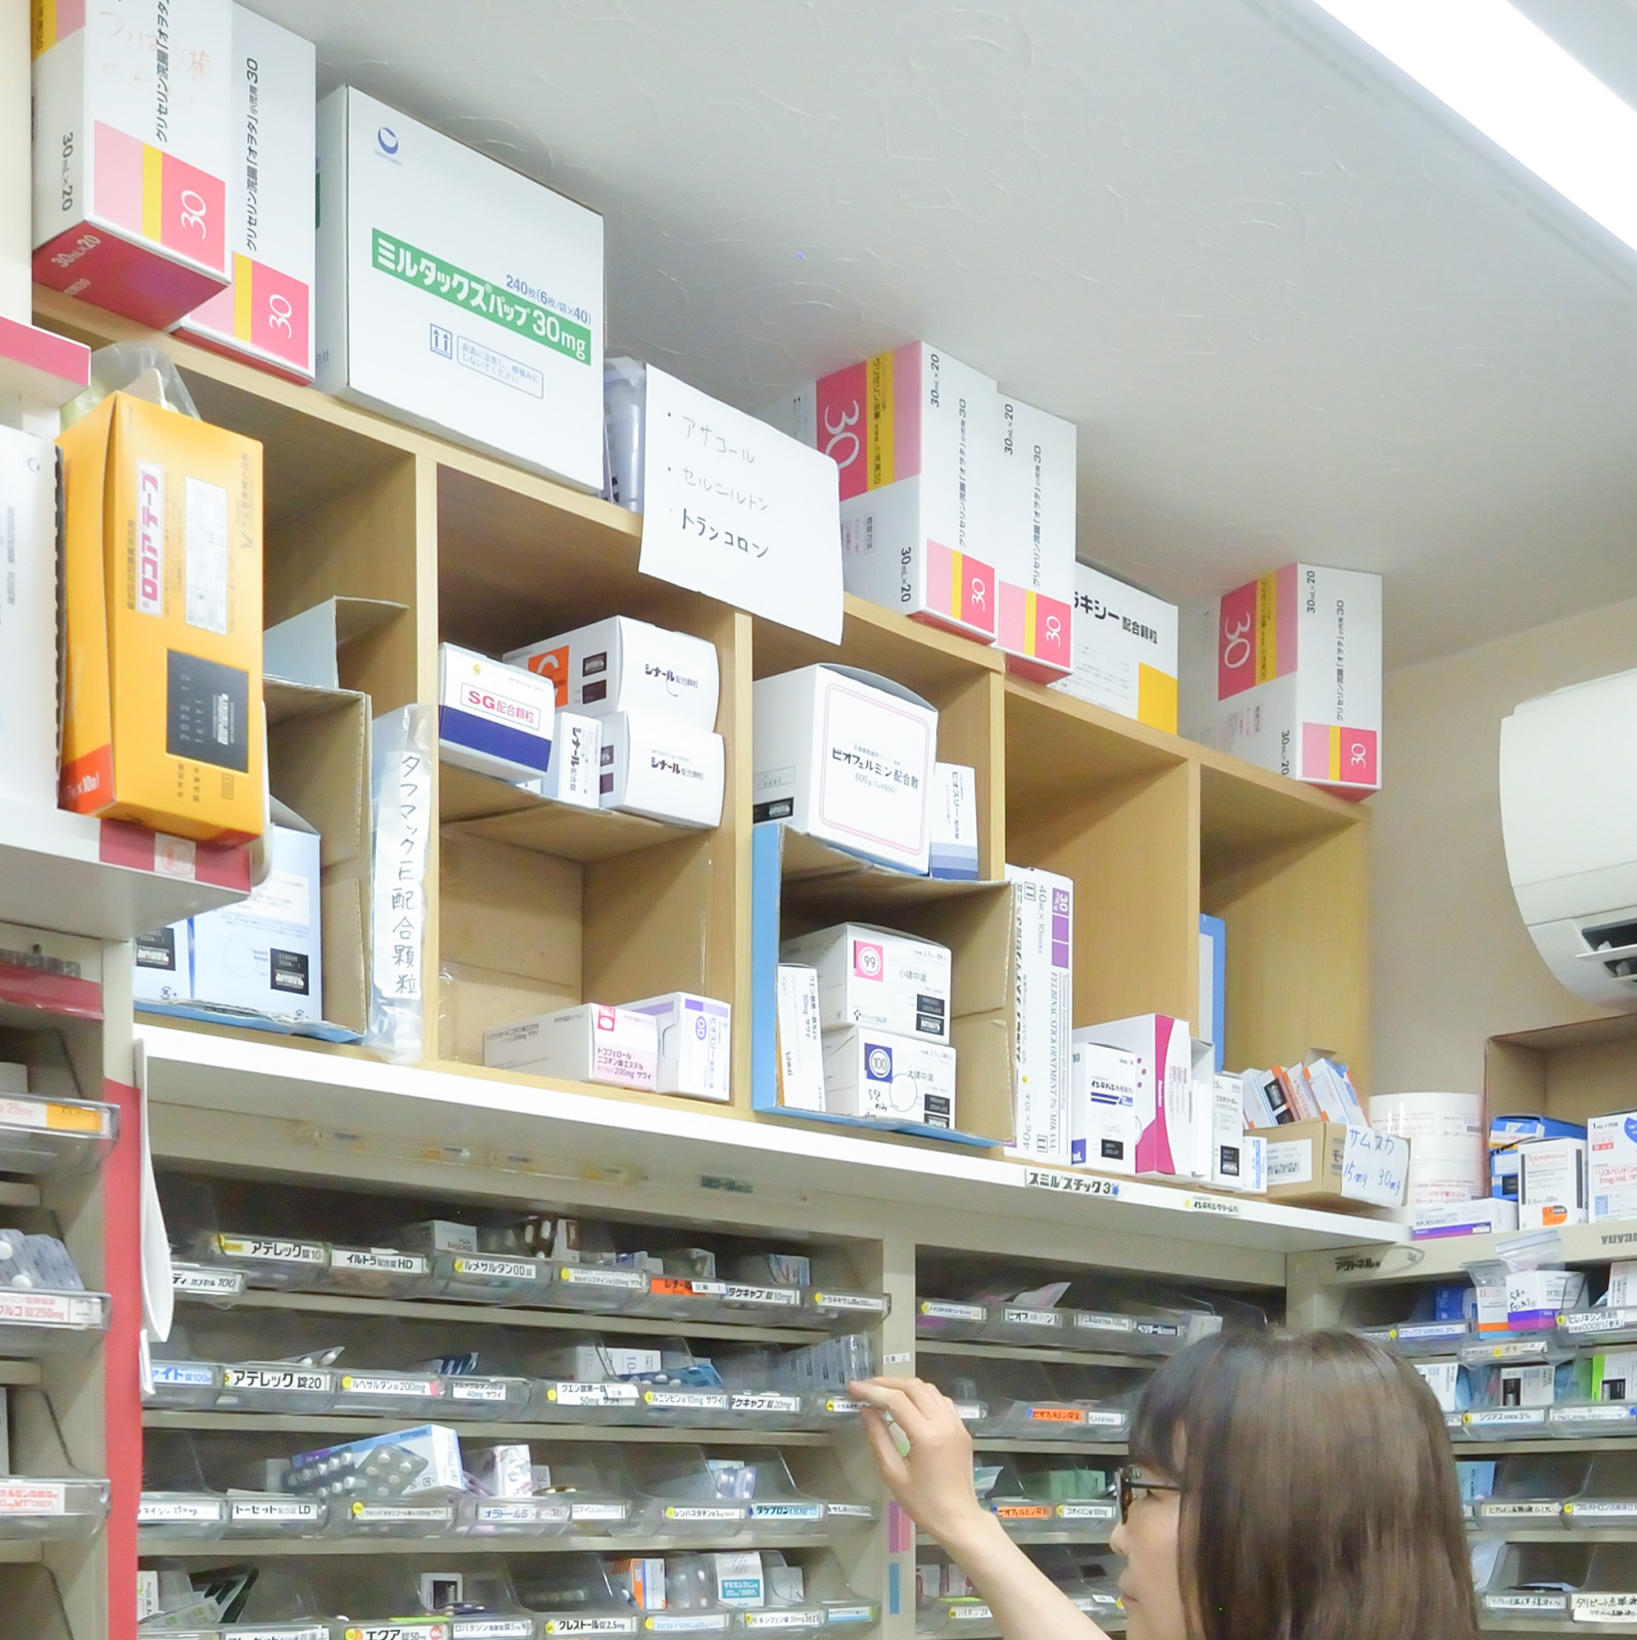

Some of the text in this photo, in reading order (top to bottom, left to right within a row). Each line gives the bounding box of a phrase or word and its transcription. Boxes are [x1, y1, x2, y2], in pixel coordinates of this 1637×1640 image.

[180, 188, 208, 241] 30
[269, 292, 294, 340] 30
[682, 416, 755, 463] アサコール
[823, 399, 860, 471] 30
[141, 469, 159, 604] ロコアテープ
[680, 508, 769, 559] トランコロン
[972, 577, 986, 611] 30
[1046, 615, 1061, 645] 30
[1224, 611, 1250, 669] 30
[644, 663, 699, 692] シナール配合顆粒
[467, 689, 537, 725] SG配合顆粒
[1351, 742, 1366, 768] 30
[863, 955, 877, 970] 99
[872, 1056, 888, 1072] 100
[1347, 1128, 1395, 1156] サムスカ
[251, 1242, 321, 1260] アテレック錠10
[347, 1254, 413, 1269] イルトラ配合錠HD
[233, 1370, 321, 1389] アテレック錠20
